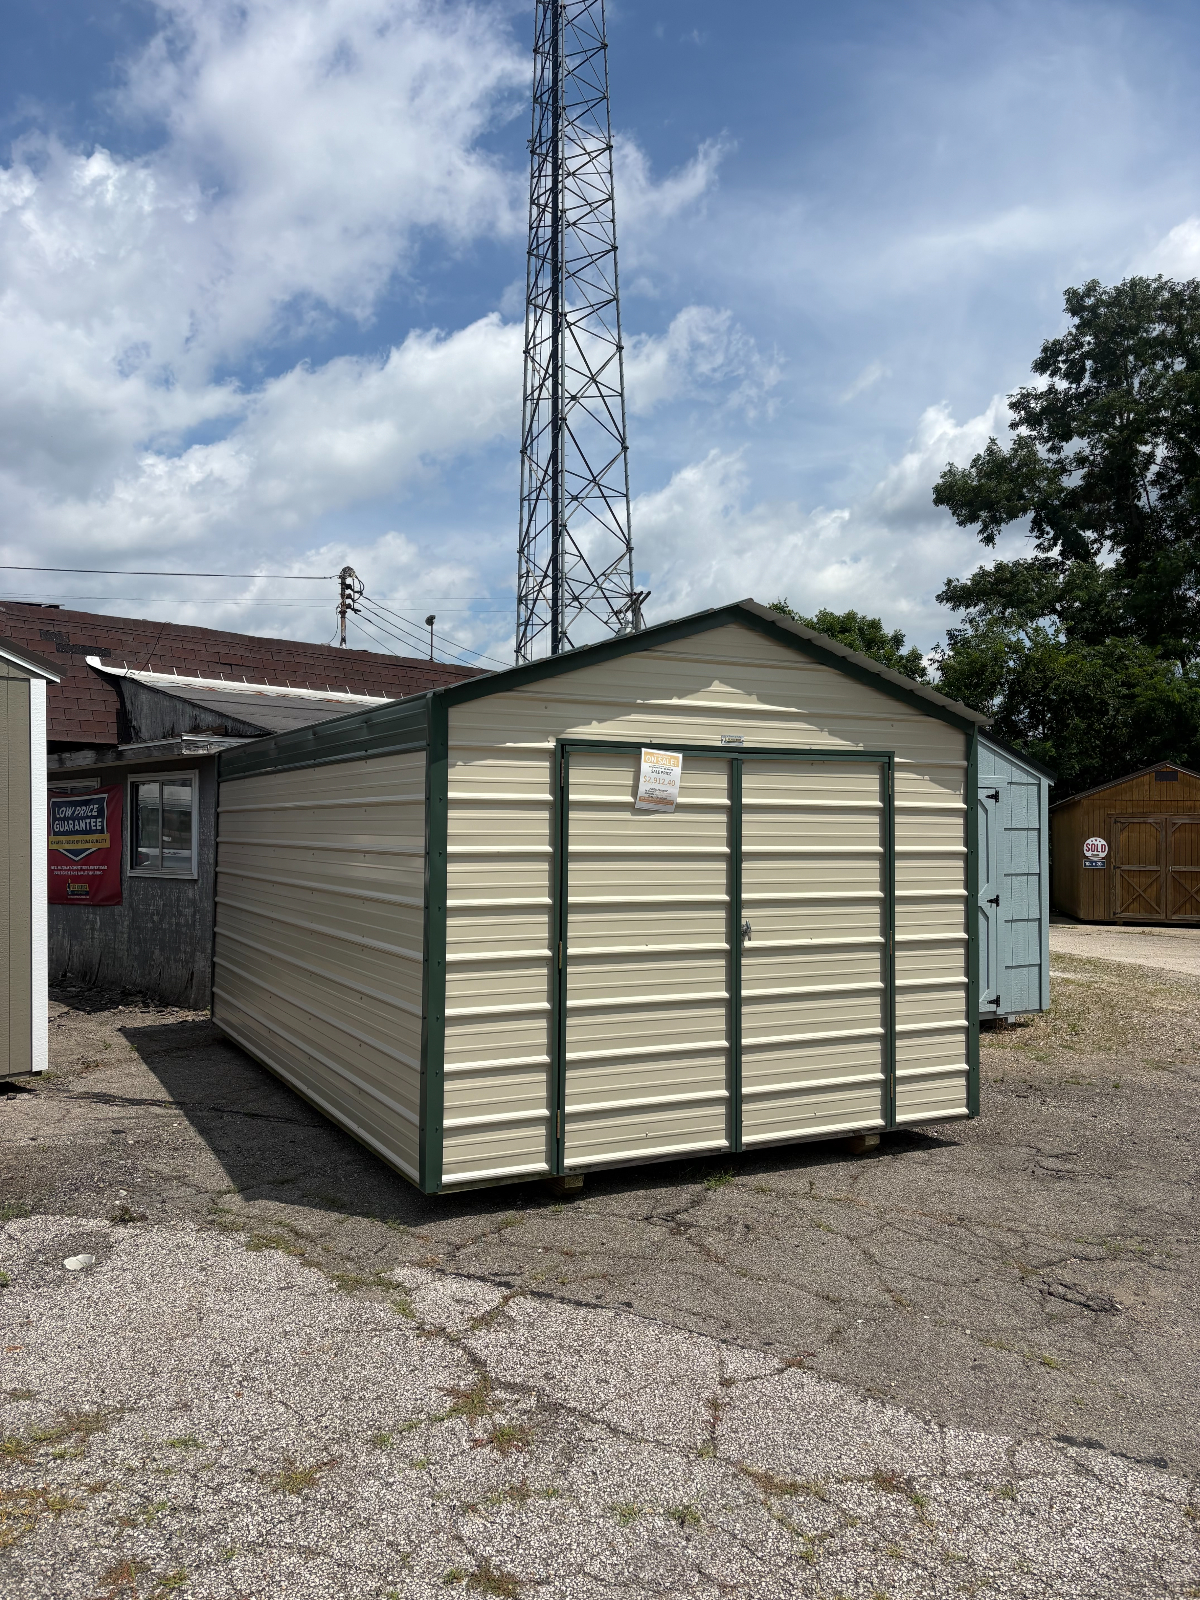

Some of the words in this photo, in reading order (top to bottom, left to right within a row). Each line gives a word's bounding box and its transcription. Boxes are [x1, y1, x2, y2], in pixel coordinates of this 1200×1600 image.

[646, 755, 657, 763] ON
[658, 757, 677, 767] SALE!
[643, 775, 676, 787] $2,912.40
[55, 806, 74, 818] LOW
[74, 804, 99, 817] PRICE
[54, 819, 102, 832] GUARANTEE
[1086, 843, 1106, 853] SOLD
